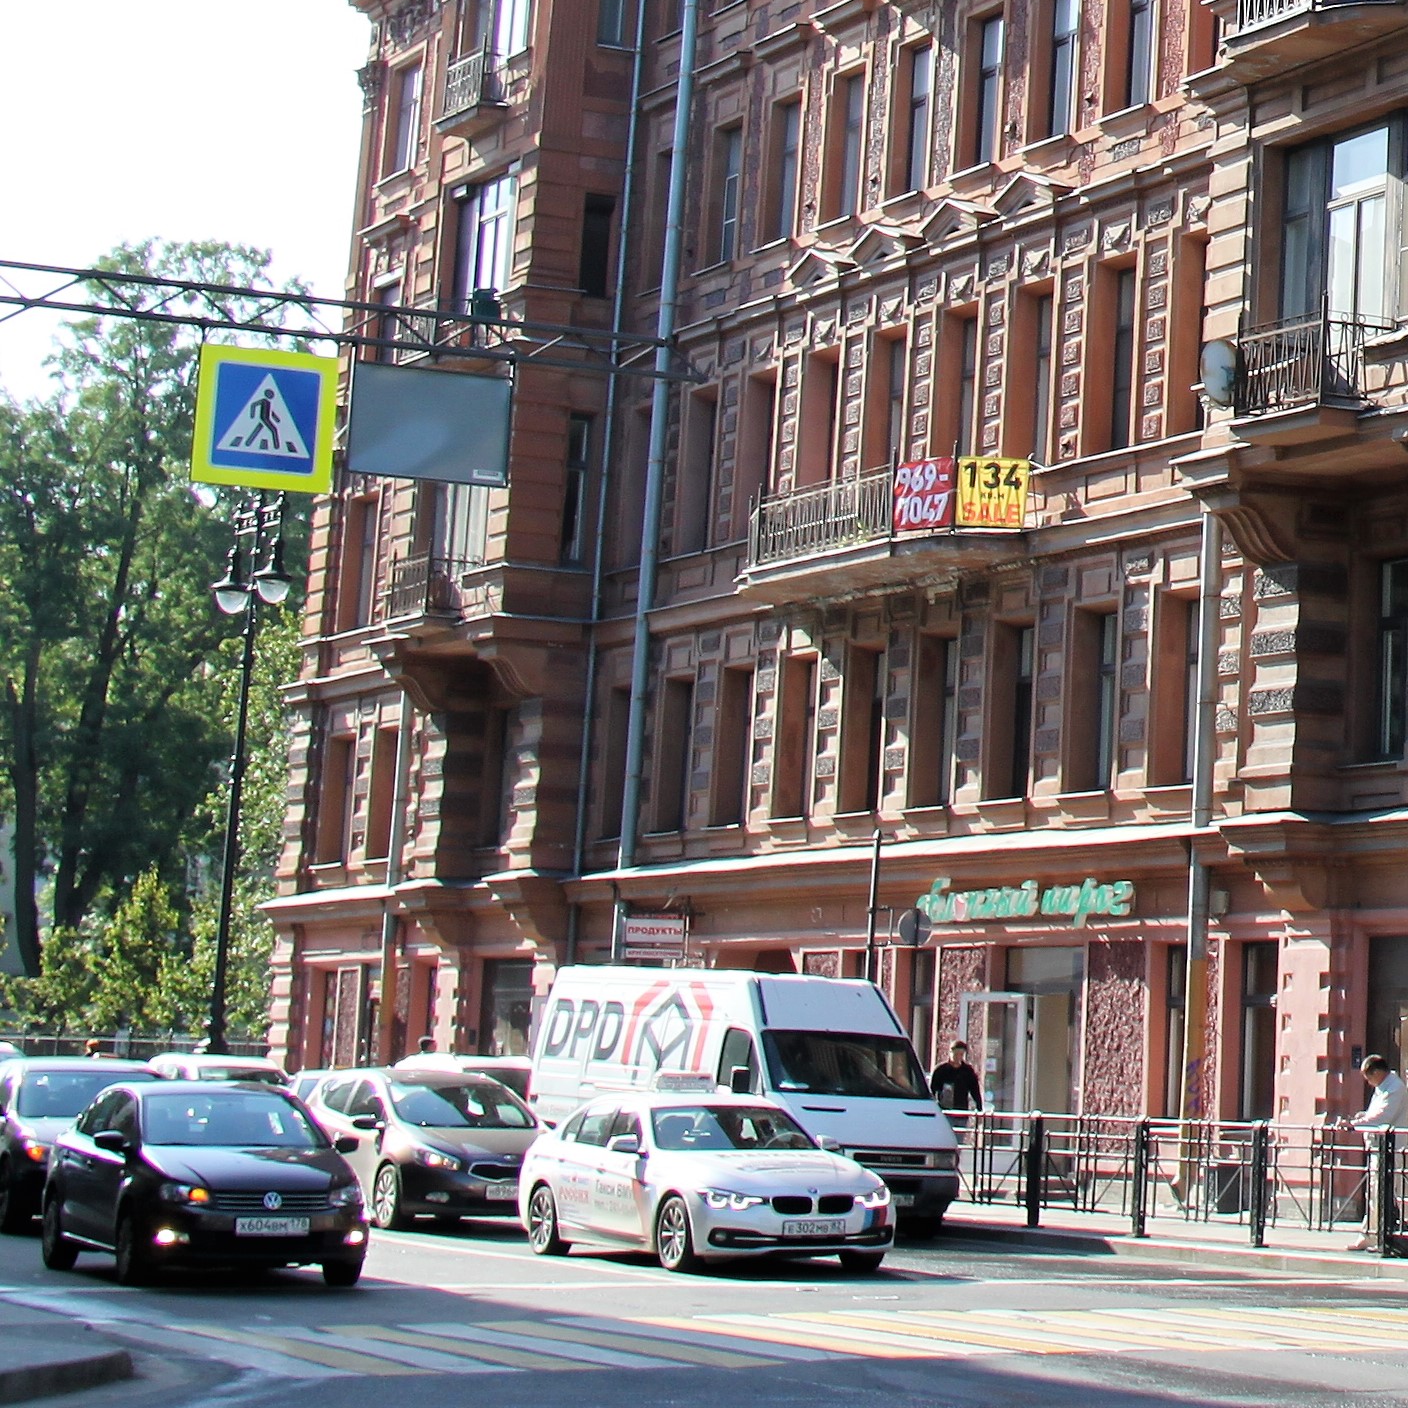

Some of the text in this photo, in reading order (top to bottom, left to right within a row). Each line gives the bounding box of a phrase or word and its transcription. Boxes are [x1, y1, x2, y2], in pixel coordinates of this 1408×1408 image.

[964, 460, 1023, 490] 134
[963, 501, 1021, 524] SALE
[1041, 877, 1134, 929] пирог
[627, 925, 683, 936] ПРОДУКТЫ
[544, 997, 625, 1060] DPD
